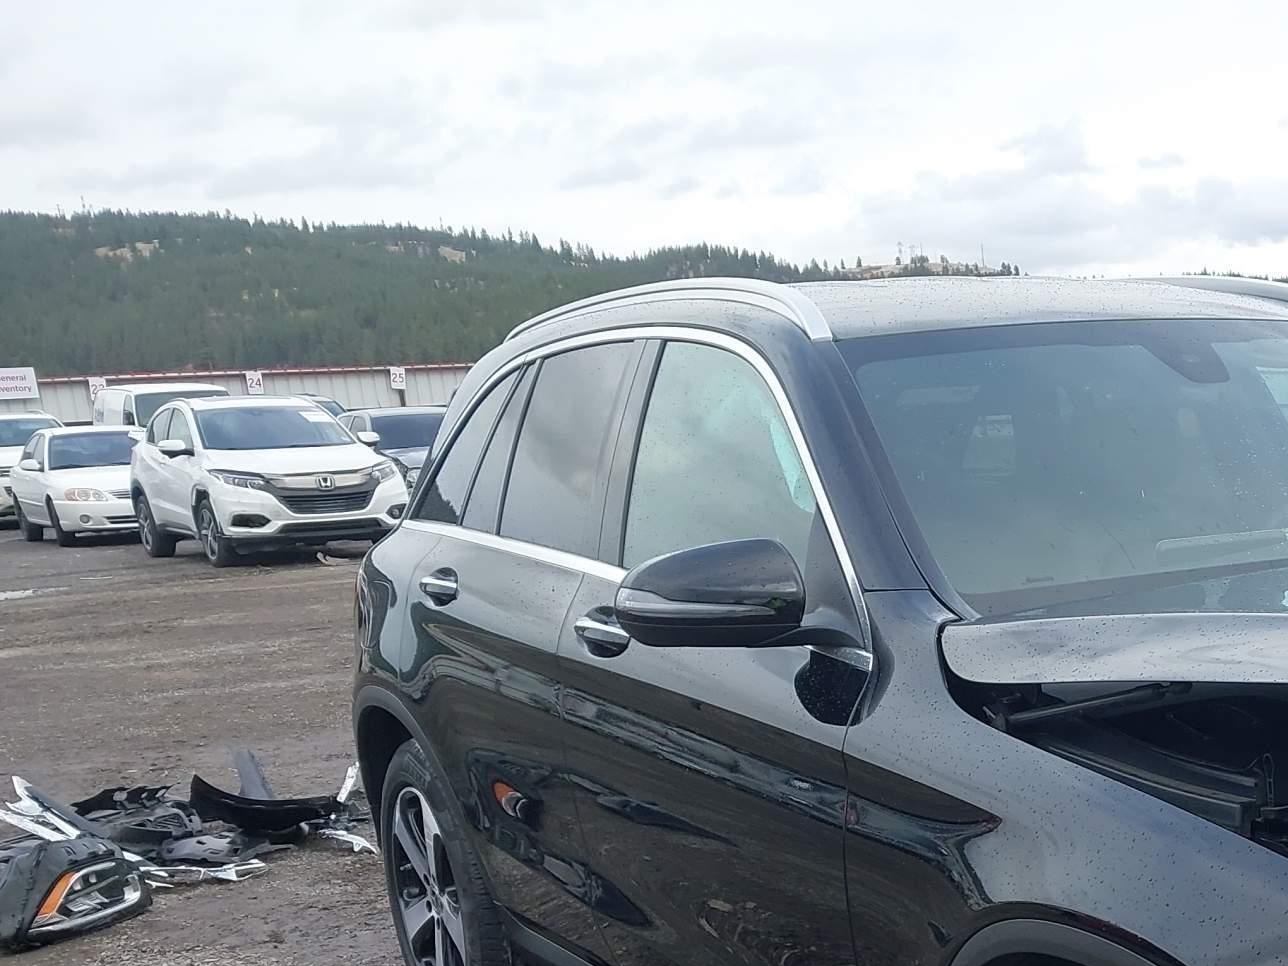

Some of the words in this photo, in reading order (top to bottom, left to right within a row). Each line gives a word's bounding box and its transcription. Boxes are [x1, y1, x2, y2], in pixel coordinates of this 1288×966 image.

[0, 374, 27, 382] eneral
[391, 372, 404, 383] 25
[247, 377, 262, 389] 24
[0, 385, 32, 393] ventory
